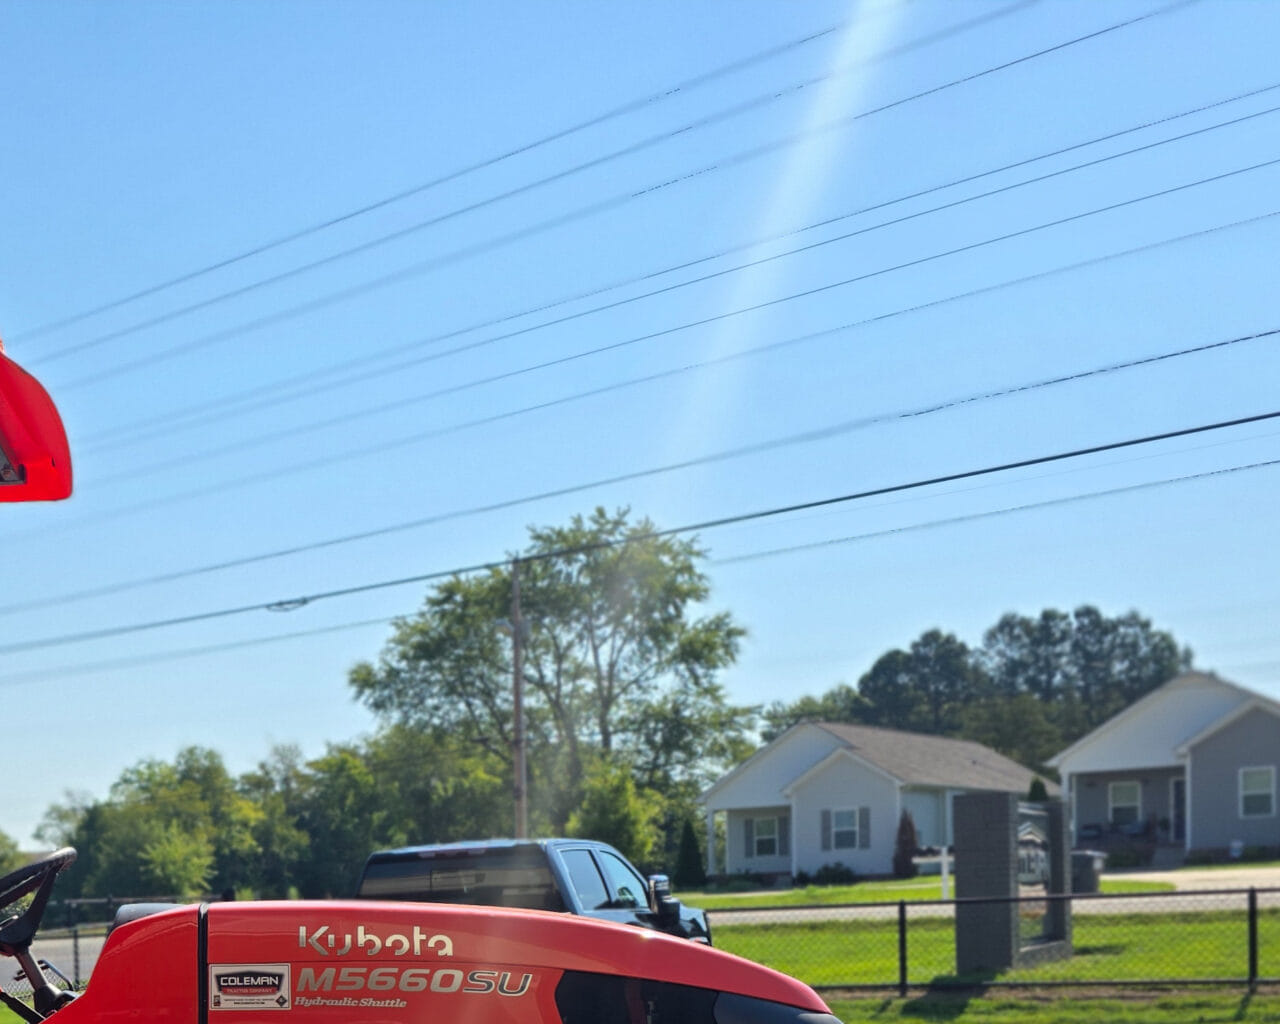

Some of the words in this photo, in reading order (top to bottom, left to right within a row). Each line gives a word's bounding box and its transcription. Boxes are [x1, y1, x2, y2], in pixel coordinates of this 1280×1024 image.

[298, 925, 454, 957] Kubota
[220, 976, 279, 986] COLEMAN
[296, 967, 533, 997] M5660SU
[294, 996, 359, 1007] Hydraulic
[359, 997, 407, 1008] Shuttle
